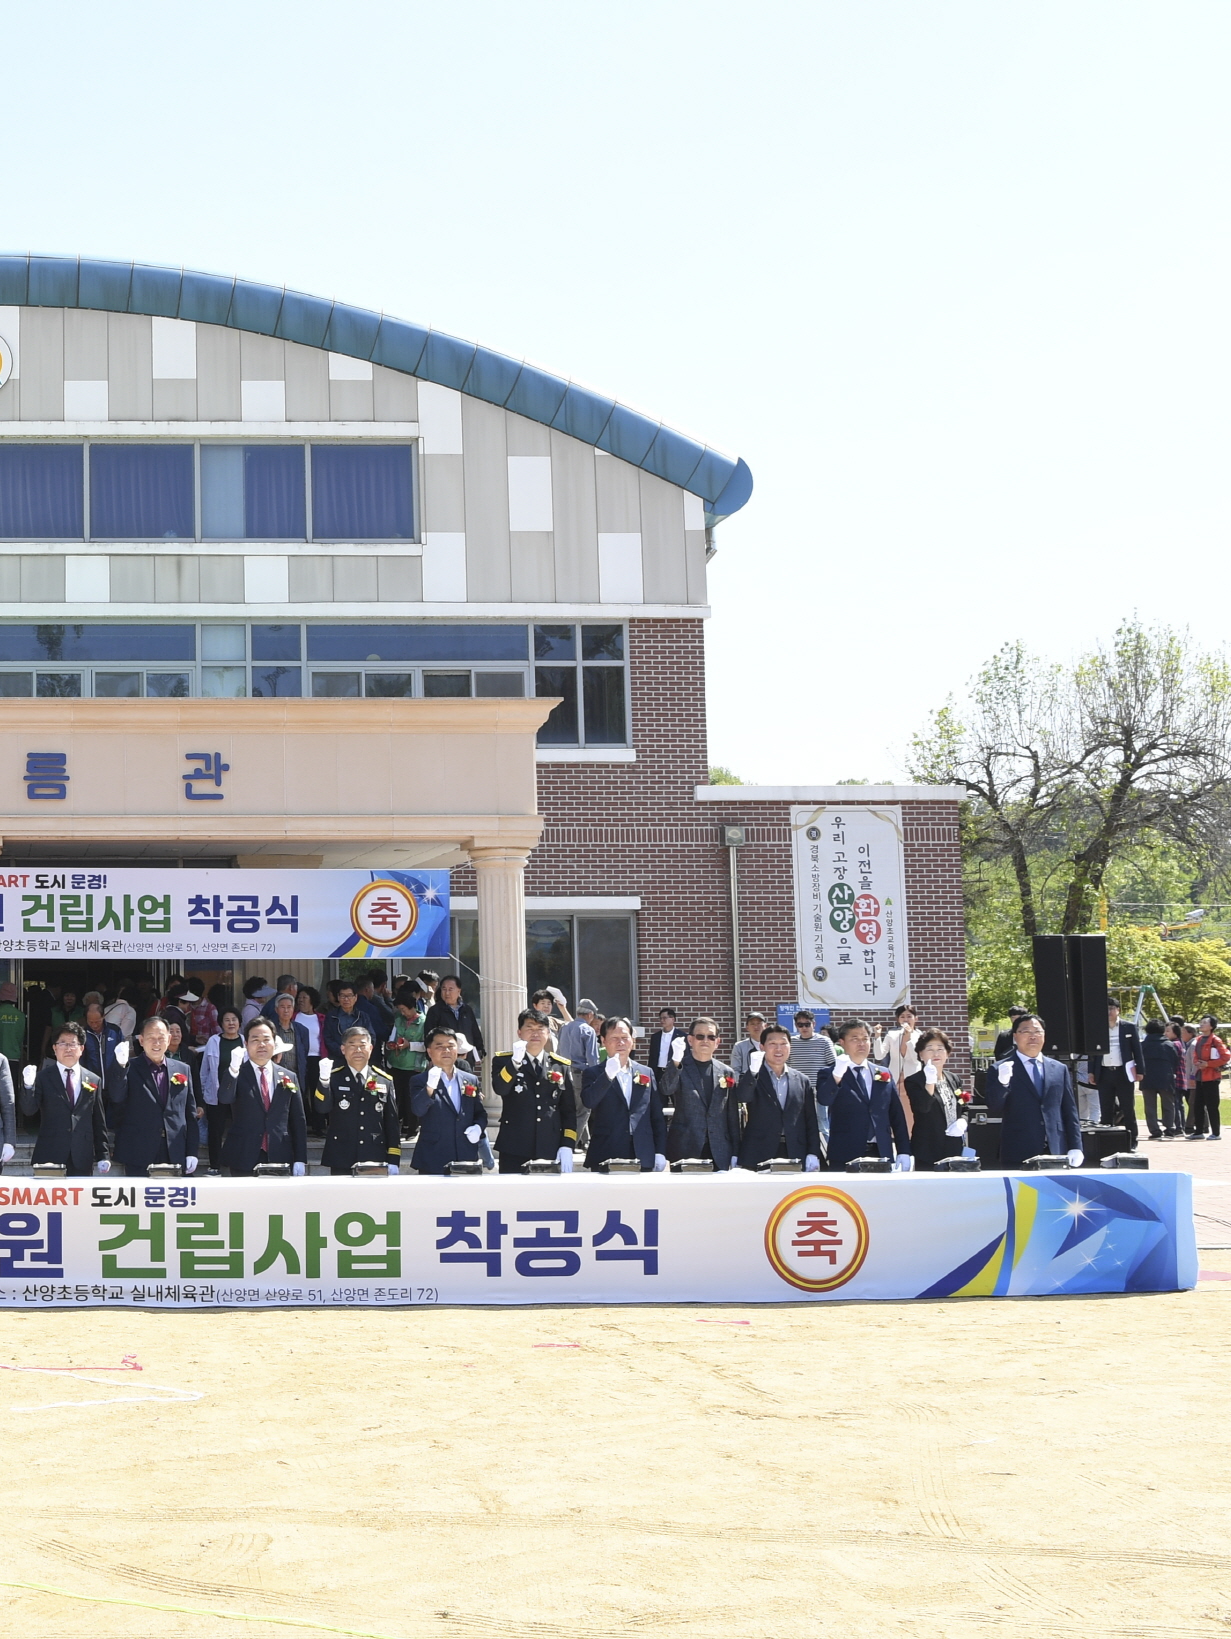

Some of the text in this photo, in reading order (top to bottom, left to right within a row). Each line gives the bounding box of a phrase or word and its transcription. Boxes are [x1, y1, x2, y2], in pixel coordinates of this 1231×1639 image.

[34, 873, 66, 889] 도시
[70, 873, 108, 889] 문경!
[831, 816, 855, 966] 우리 고장 산양으로
[20, 893, 172, 934] 건립사업
[187, 894, 300, 934] 착공식
[366, 896, 402, 931] 축
[810, 844, 824, 963] 경북소방장비 기술원 기공식
[855, 843, 880, 997] 이전을 환영합니다
[156, 942, 184, 953] 산양로
[186, 942, 199, 954] 51,
[201, 942, 229, 953] 산양면
[260, 942, 276, 954] 72)
[888, 971, 896, 988] 일동
[90, 1186, 136, 1208] 도시
[143, 1186, 197, 1208] 문경!
[98, 1210, 402, 1279] 건립사업
[435, 1208, 660, 1278] 착공식
[790, 1211, 843, 1266] 축
[22, 1283, 125, 1303] 산양초등학교
[265, 1288, 303, 1302] 산양로
[307, 1288, 326, 1304] 51,
[330, 1288, 370, 1302] 산양면
[374, 1288, 413, 1302] 존도리
[416, 1287, 439, 1303] 72)
